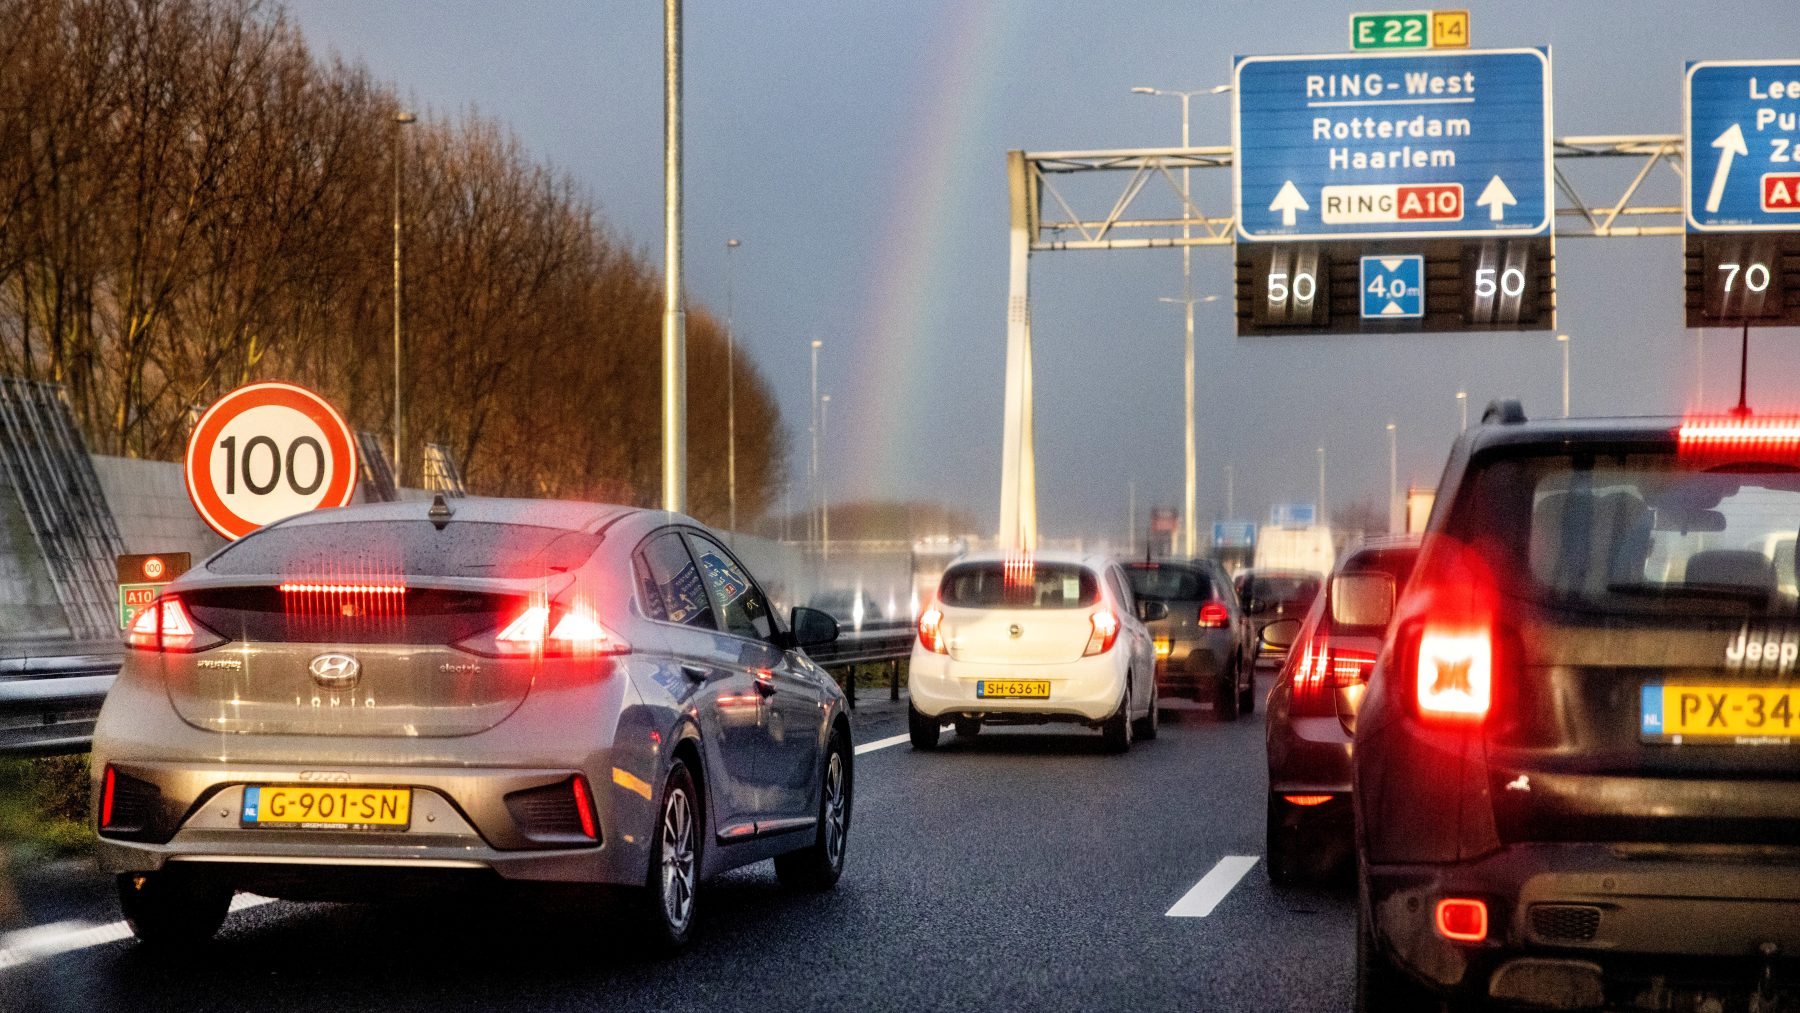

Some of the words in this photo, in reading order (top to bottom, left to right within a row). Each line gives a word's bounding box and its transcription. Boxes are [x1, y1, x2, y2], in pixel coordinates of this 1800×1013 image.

[1358, 20, 1376, 43] E
[1383, 20, 1423, 43] 22
[1438, 22, 1463, 38] 14
[1306, 71, 1475, 98] RING-West
[1312, 115, 1471, 140] Rotterdam
[1757, 108, 1800, 131] Pu
[1329, 146, 1456, 169] Haarlem
[1327, 195, 1393, 213] RING
[1402, 191, 1457, 214] A10
[1267, 273, 1317, 302] 50
[1475, 268, 1526, 297] 50
[1718, 263, 1770, 291] 70
[220, 435, 325, 495] 100
[146, 563, 161, 573] 100
[128, 591, 152, 603] A10
[1726, 635, 1799, 667] Jeep
[987, 683, 1046, 695] SH-636-N
[1645, 713, 1661, 725] NL
[1680, 693, 1800, 728] PX-34
[270, 792, 398, 819] G-901-SN
